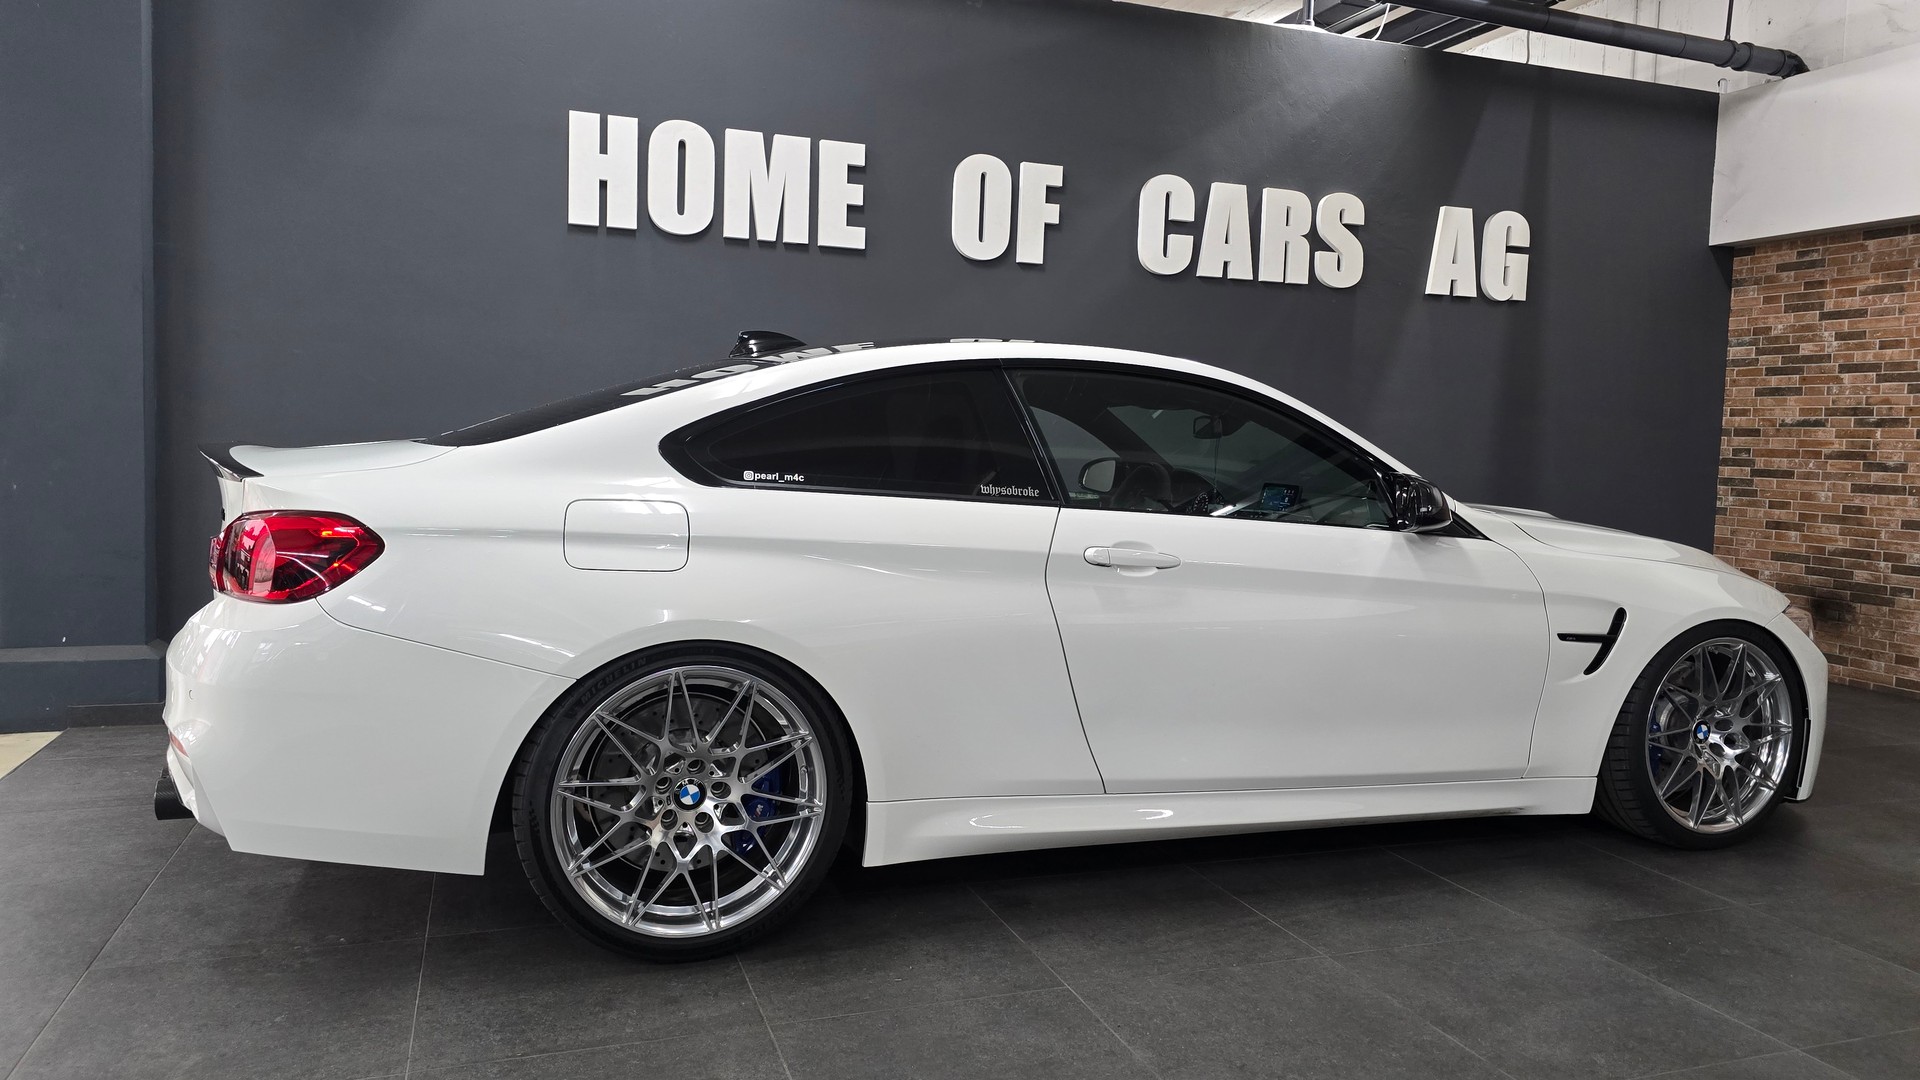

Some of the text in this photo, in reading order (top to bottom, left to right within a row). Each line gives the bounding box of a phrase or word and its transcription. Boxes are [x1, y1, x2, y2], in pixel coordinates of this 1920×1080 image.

[567, 110, 1531, 302] HOME OF CARS AG
[754, 472, 805, 483] pearl_m4c
[980, 484, 1040, 497] whysobroke
[580, 657, 647, 704] MICHELIN
